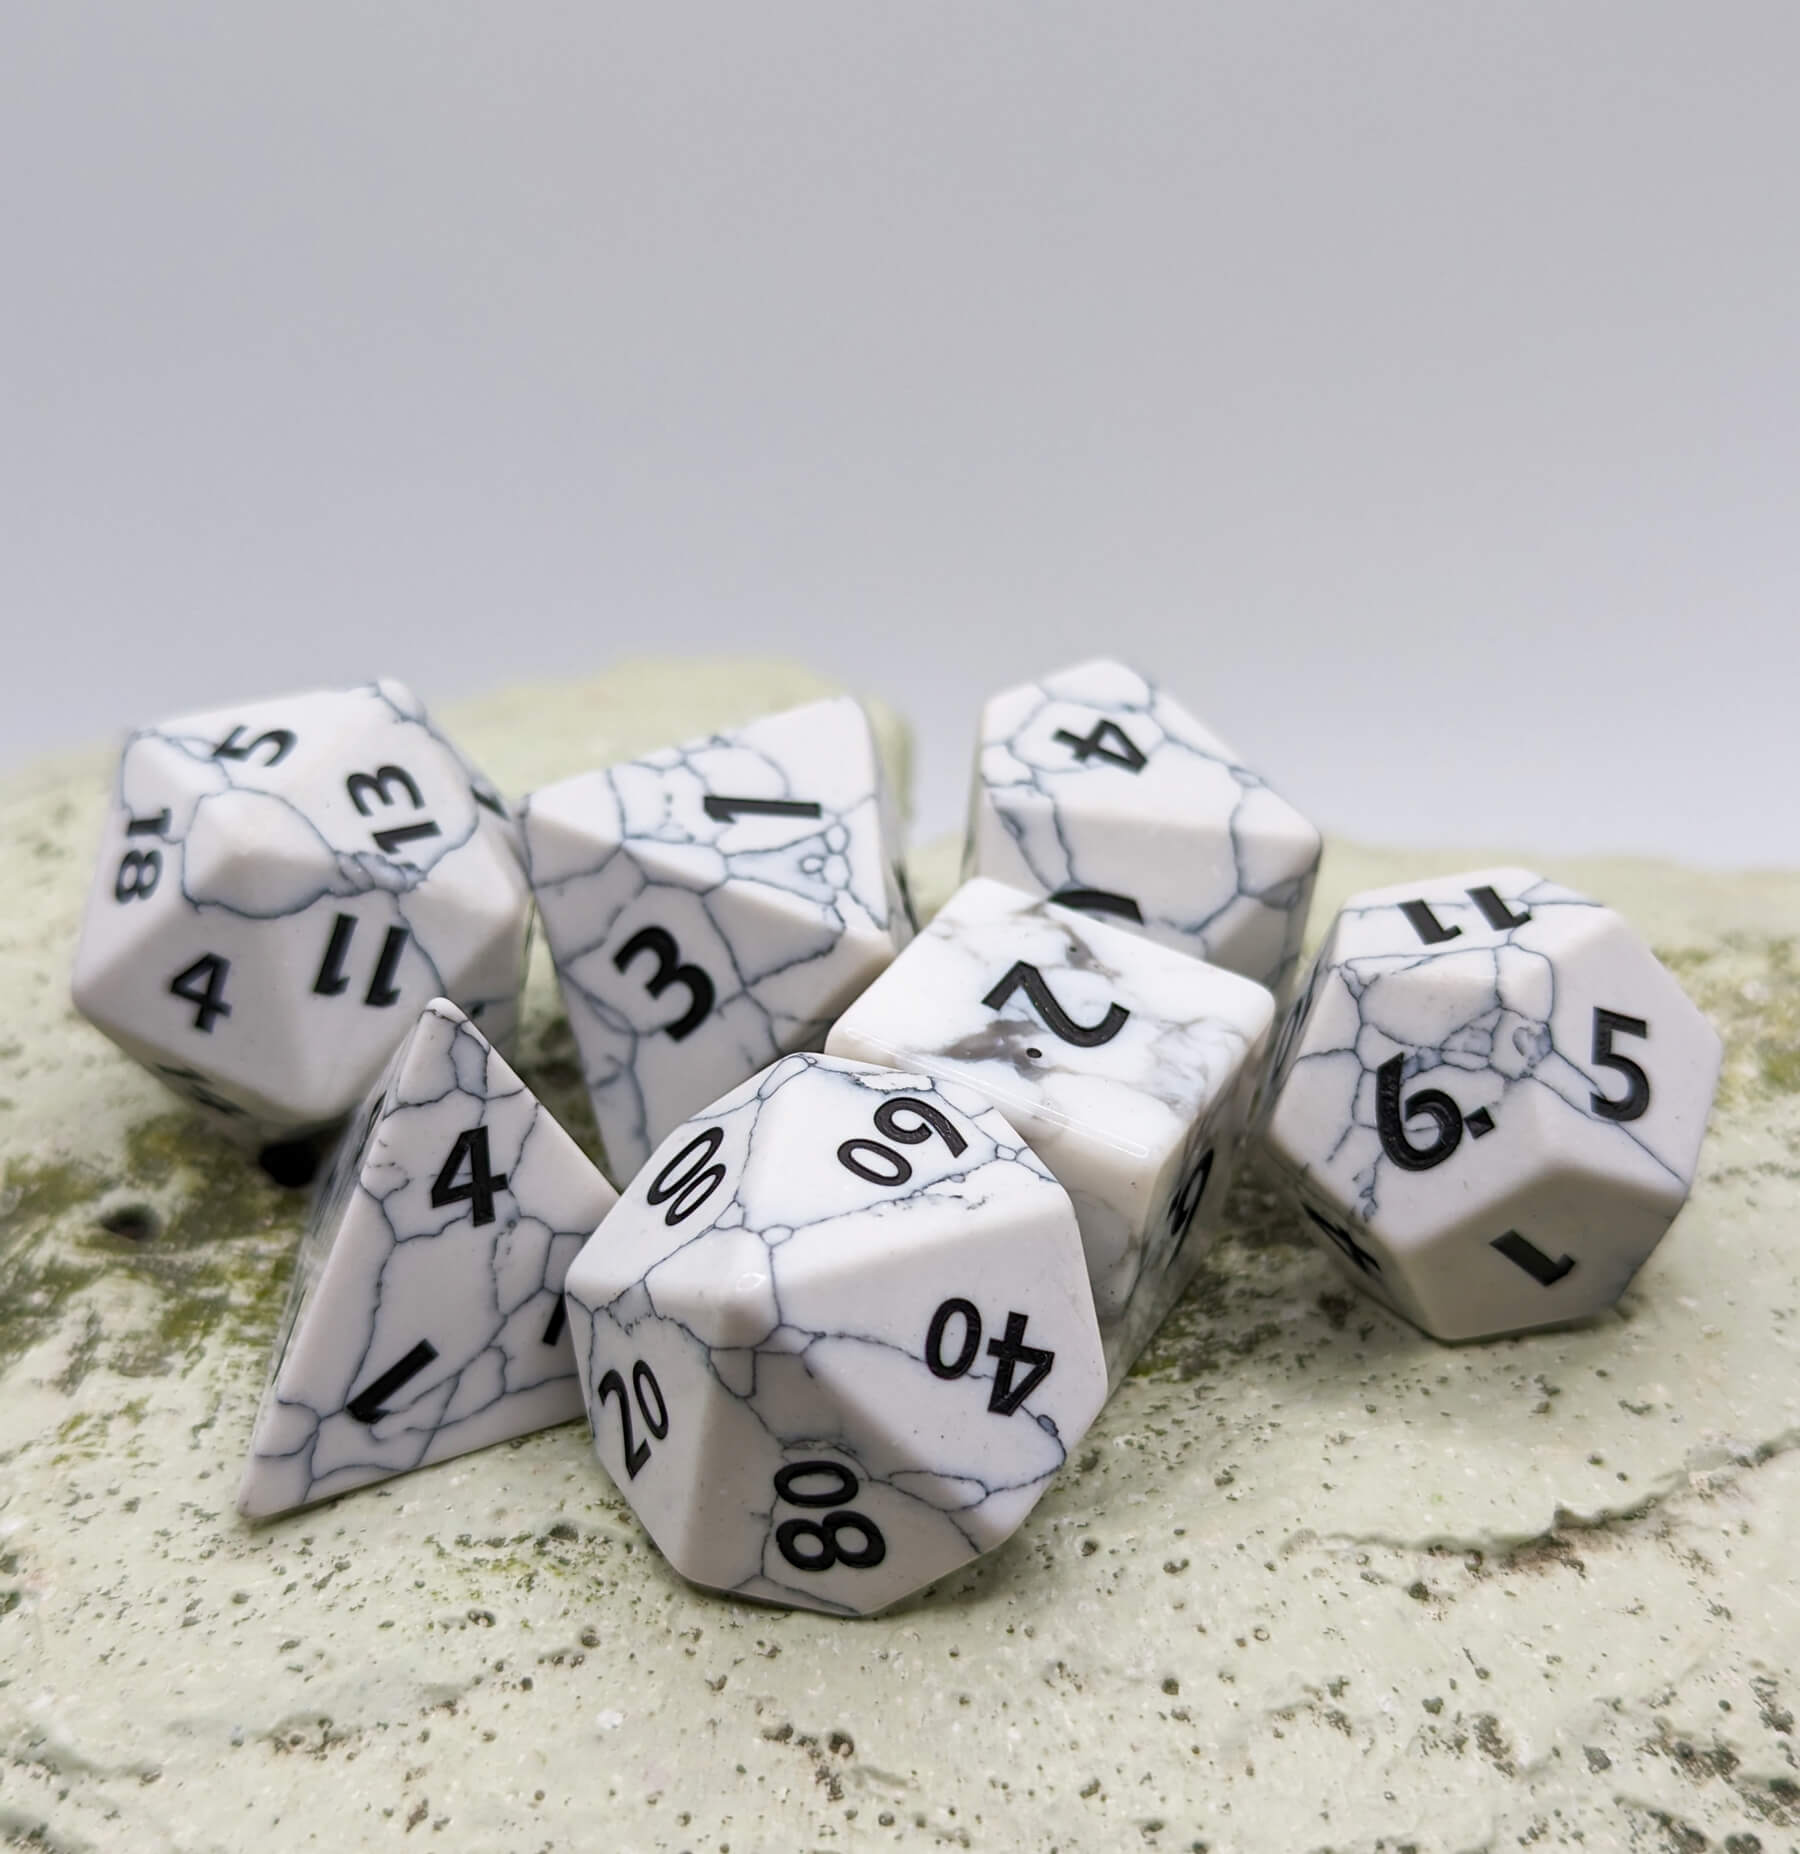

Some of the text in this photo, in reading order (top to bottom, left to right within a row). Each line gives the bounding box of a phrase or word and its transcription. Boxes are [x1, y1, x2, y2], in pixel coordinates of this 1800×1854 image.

[212, 725, 298, 767] 5
[1053, 718, 1149, 773] 4
[114, 807, 172, 904] 18
[346, 764, 441, 855] 13
[703, 795, 821, 824] 1
[313, 913, 410, 1008] 11
[1398, 885, 1531, 945] 11
[169, 953, 232, 1033] 4
[613, 925, 716, 1042] 3
[982, 960, 1130, 1048] 2
[1590, 1006, 1651, 1122] 5
[431, 1125, 510, 1227] 4
[646, 1126, 727, 1227] 00
[837, 1096, 969, 1188] 60
[1489, 1229, 1576, 1287] 1
[346, 1338, 438, 1425] 1
[925, 1297, 1055, 1418] 40
[597, 1358, 670, 1481] 20
[774, 1460, 887, 1572] 80
